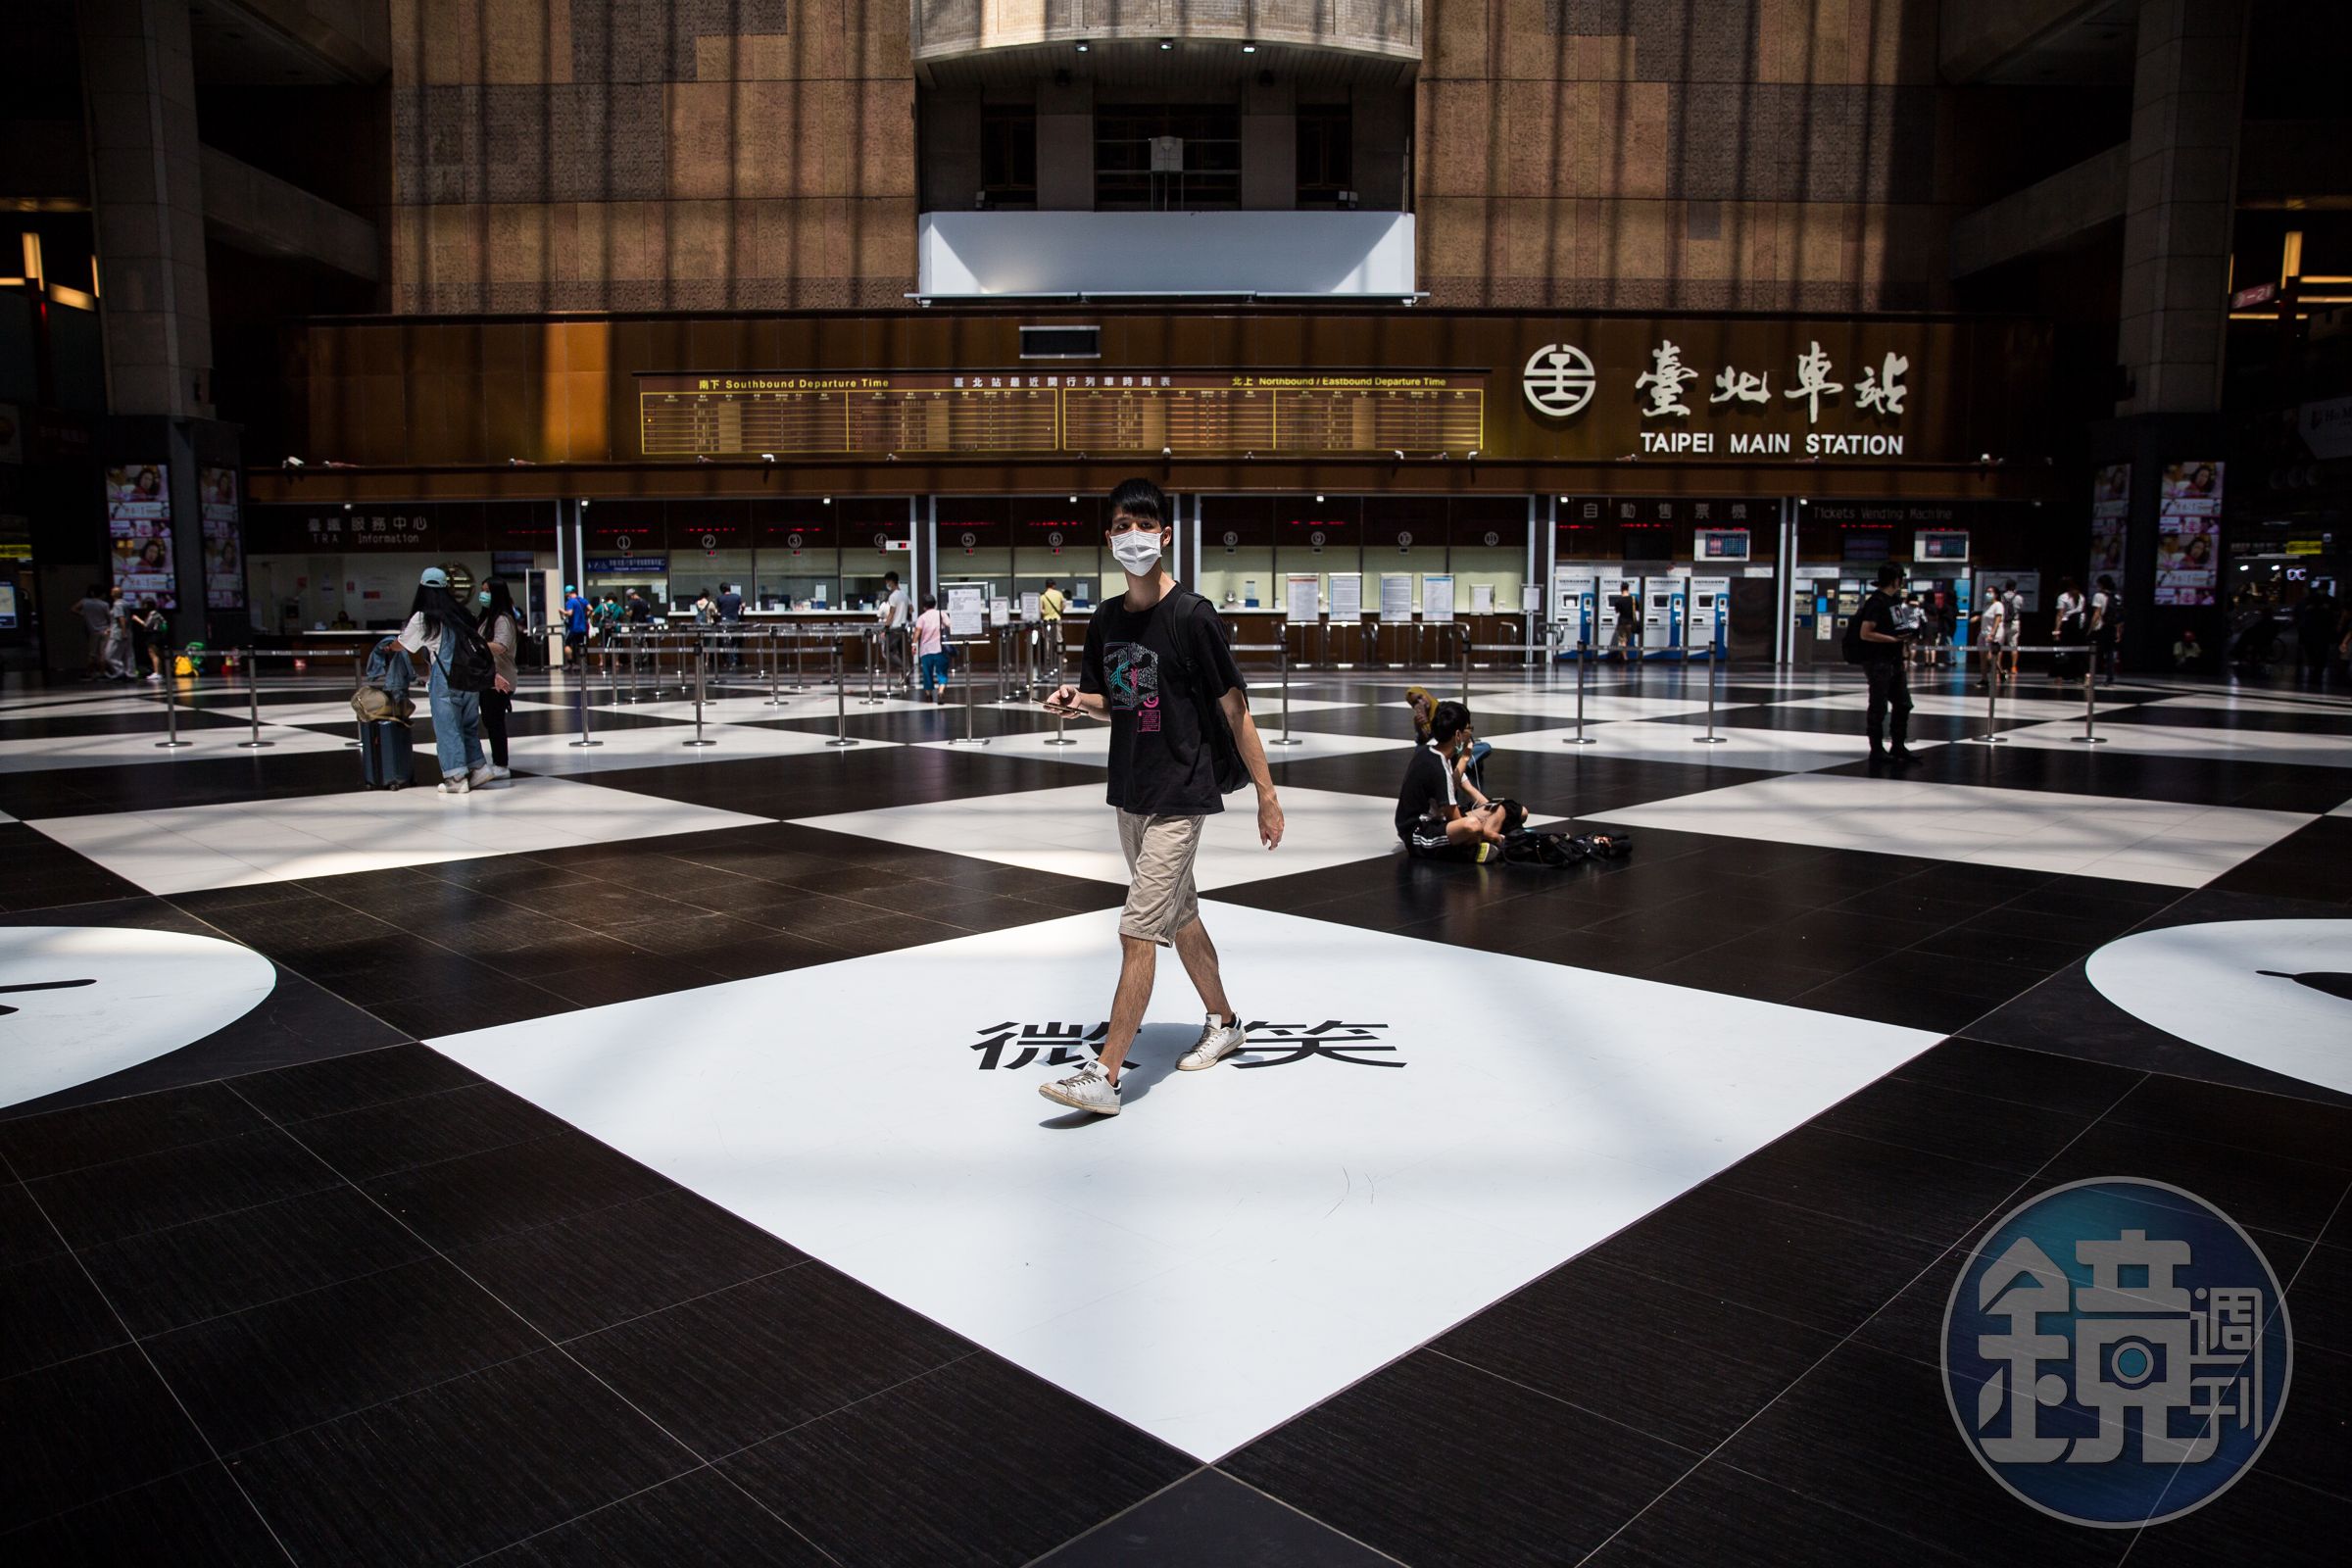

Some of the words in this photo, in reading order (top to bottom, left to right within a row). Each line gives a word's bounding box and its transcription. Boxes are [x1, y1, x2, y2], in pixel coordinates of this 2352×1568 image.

[699, 379, 720, 390] 南下
[725, 379, 795, 389] Southbound
[799, 378, 858, 389] Departure
[861, 378, 889, 388] Time
[1232, 376, 1253, 386] 北上
[1322, 377, 1372, 386] Eastbound
[1375, 377, 1421, 387] Departure
[1424, 377, 1446, 386] Time
[1635, 339, 1909, 423] 臺北車站
[1641, 432, 1714, 453] TAIPEI
[1730, 433, 1790, 453] MAIN
[1805, 433, 1903, 455] STATION
[357, 533, 419, 544] Information
